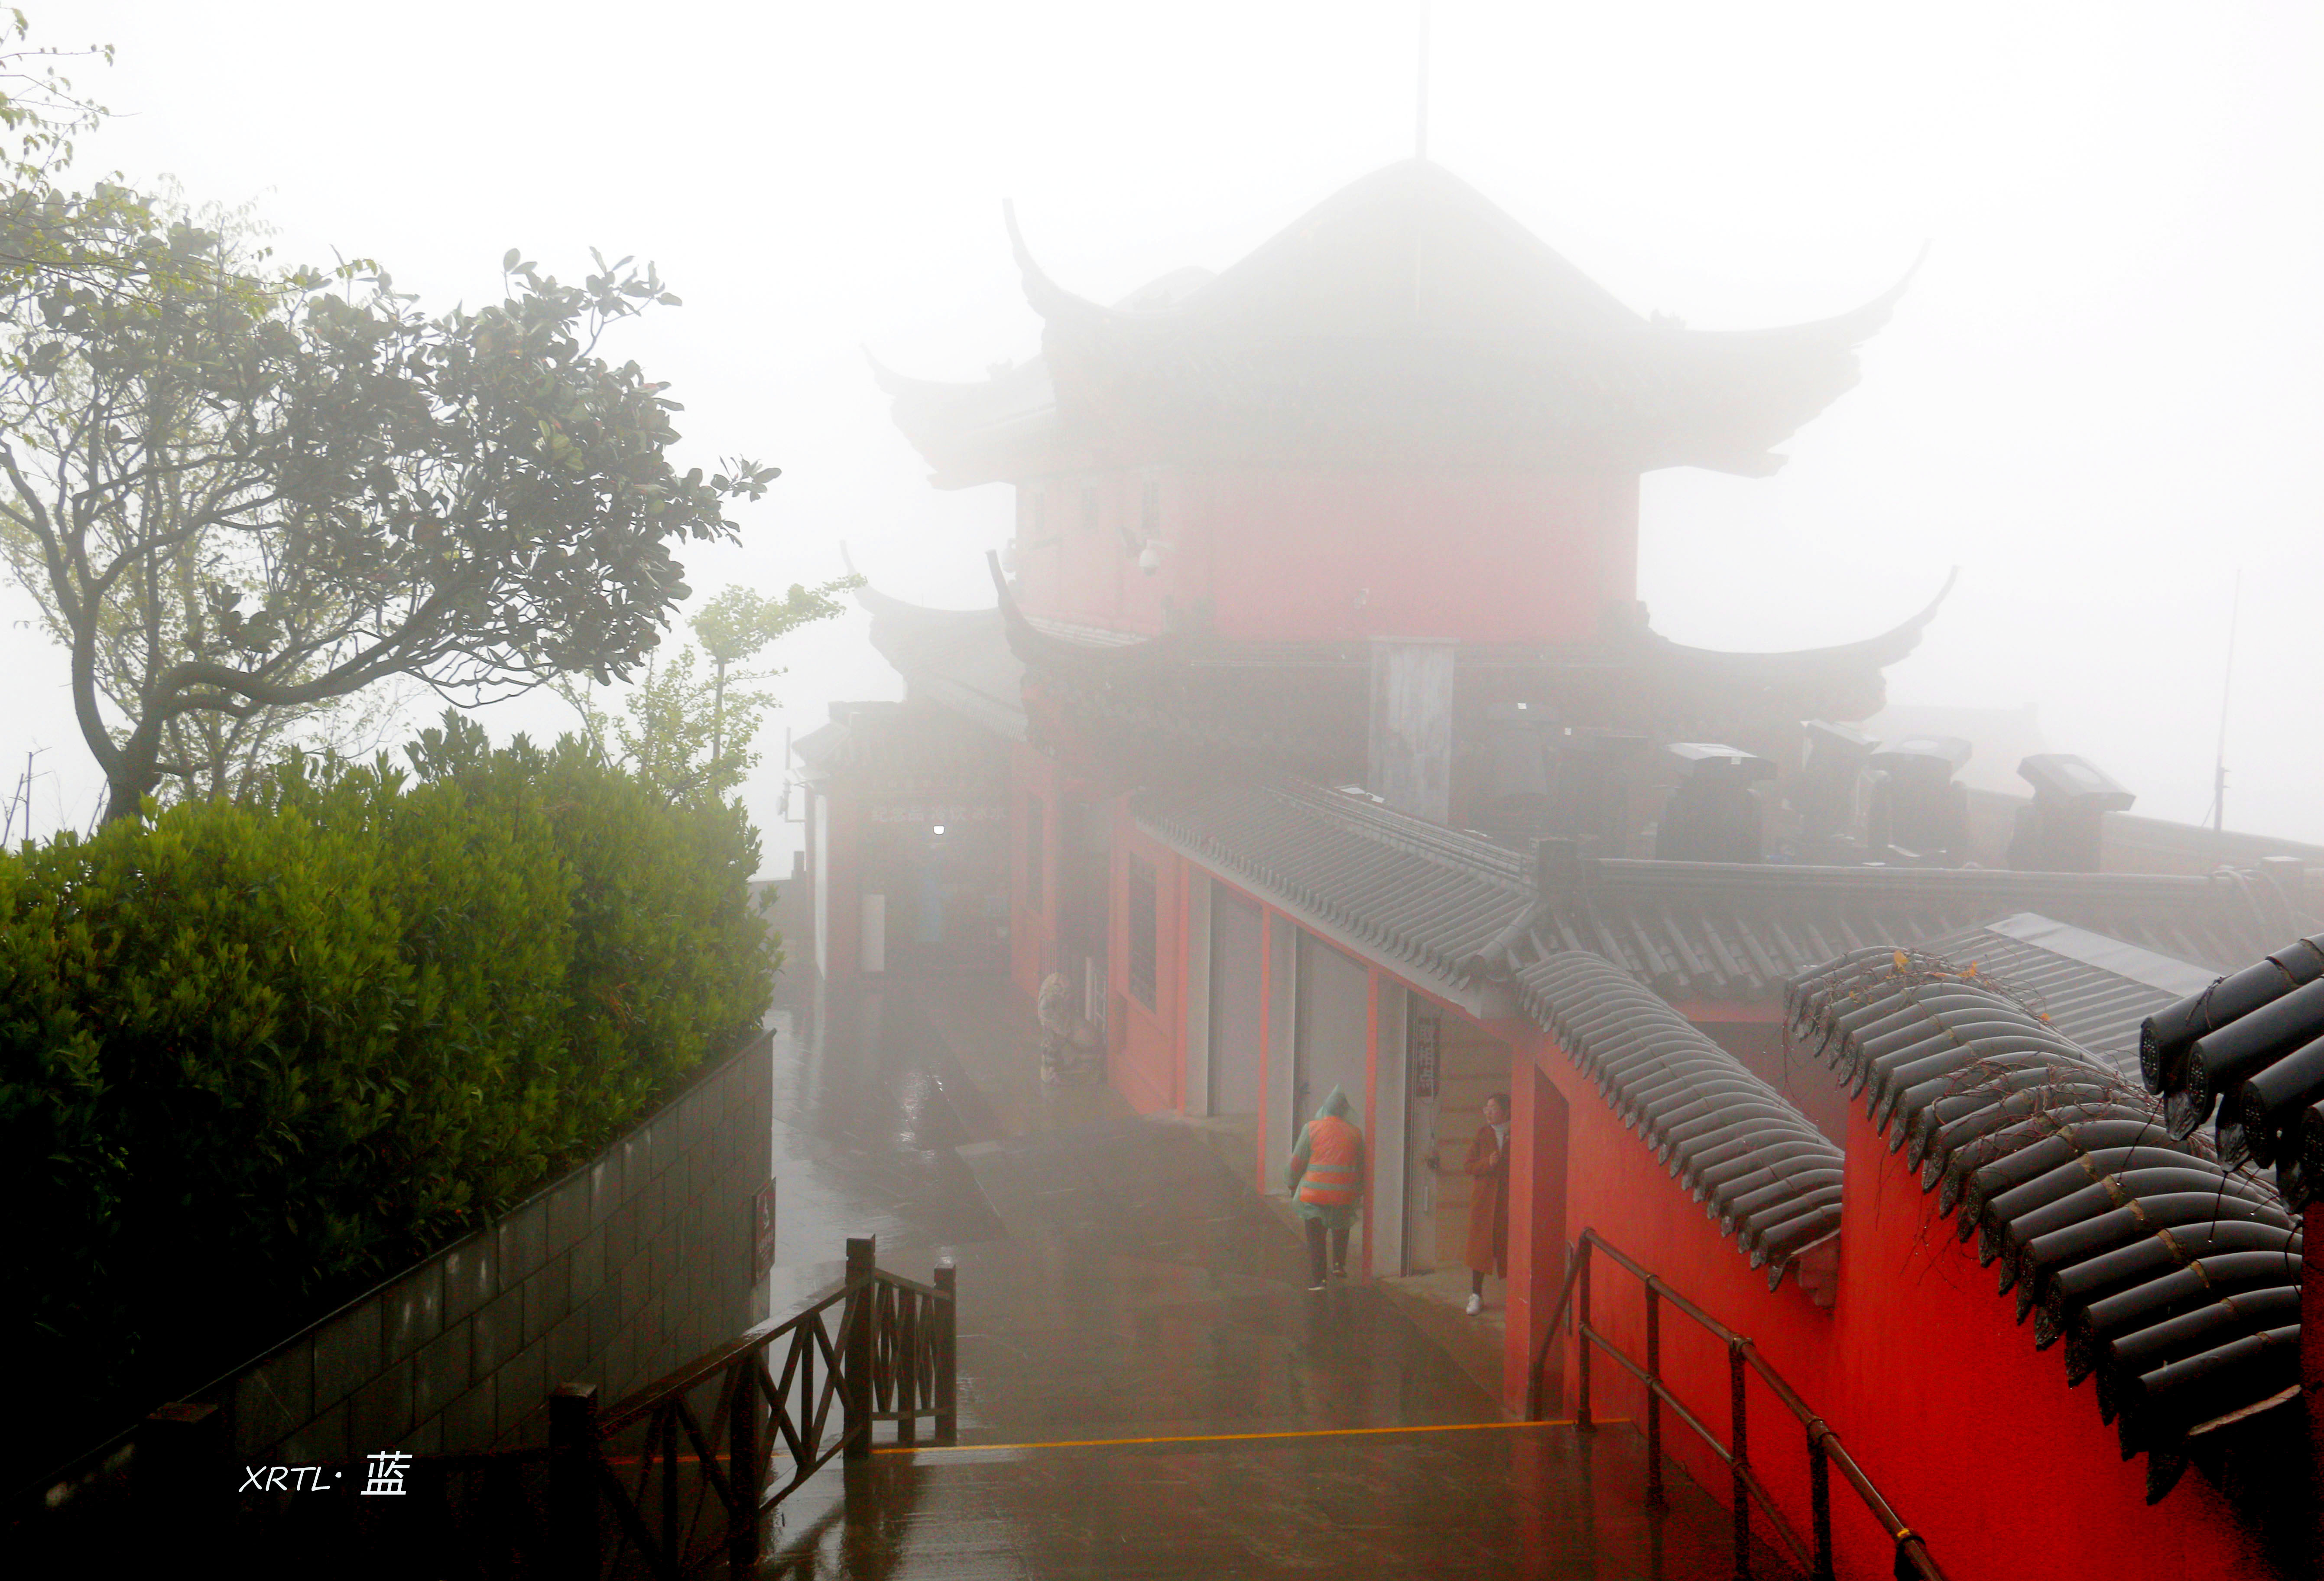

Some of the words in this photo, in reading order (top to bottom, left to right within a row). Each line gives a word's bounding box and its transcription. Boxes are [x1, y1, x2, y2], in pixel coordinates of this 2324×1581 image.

[871, 806, 924, 823] 纪念品
[931, 805, 967, 822] 冷饮
